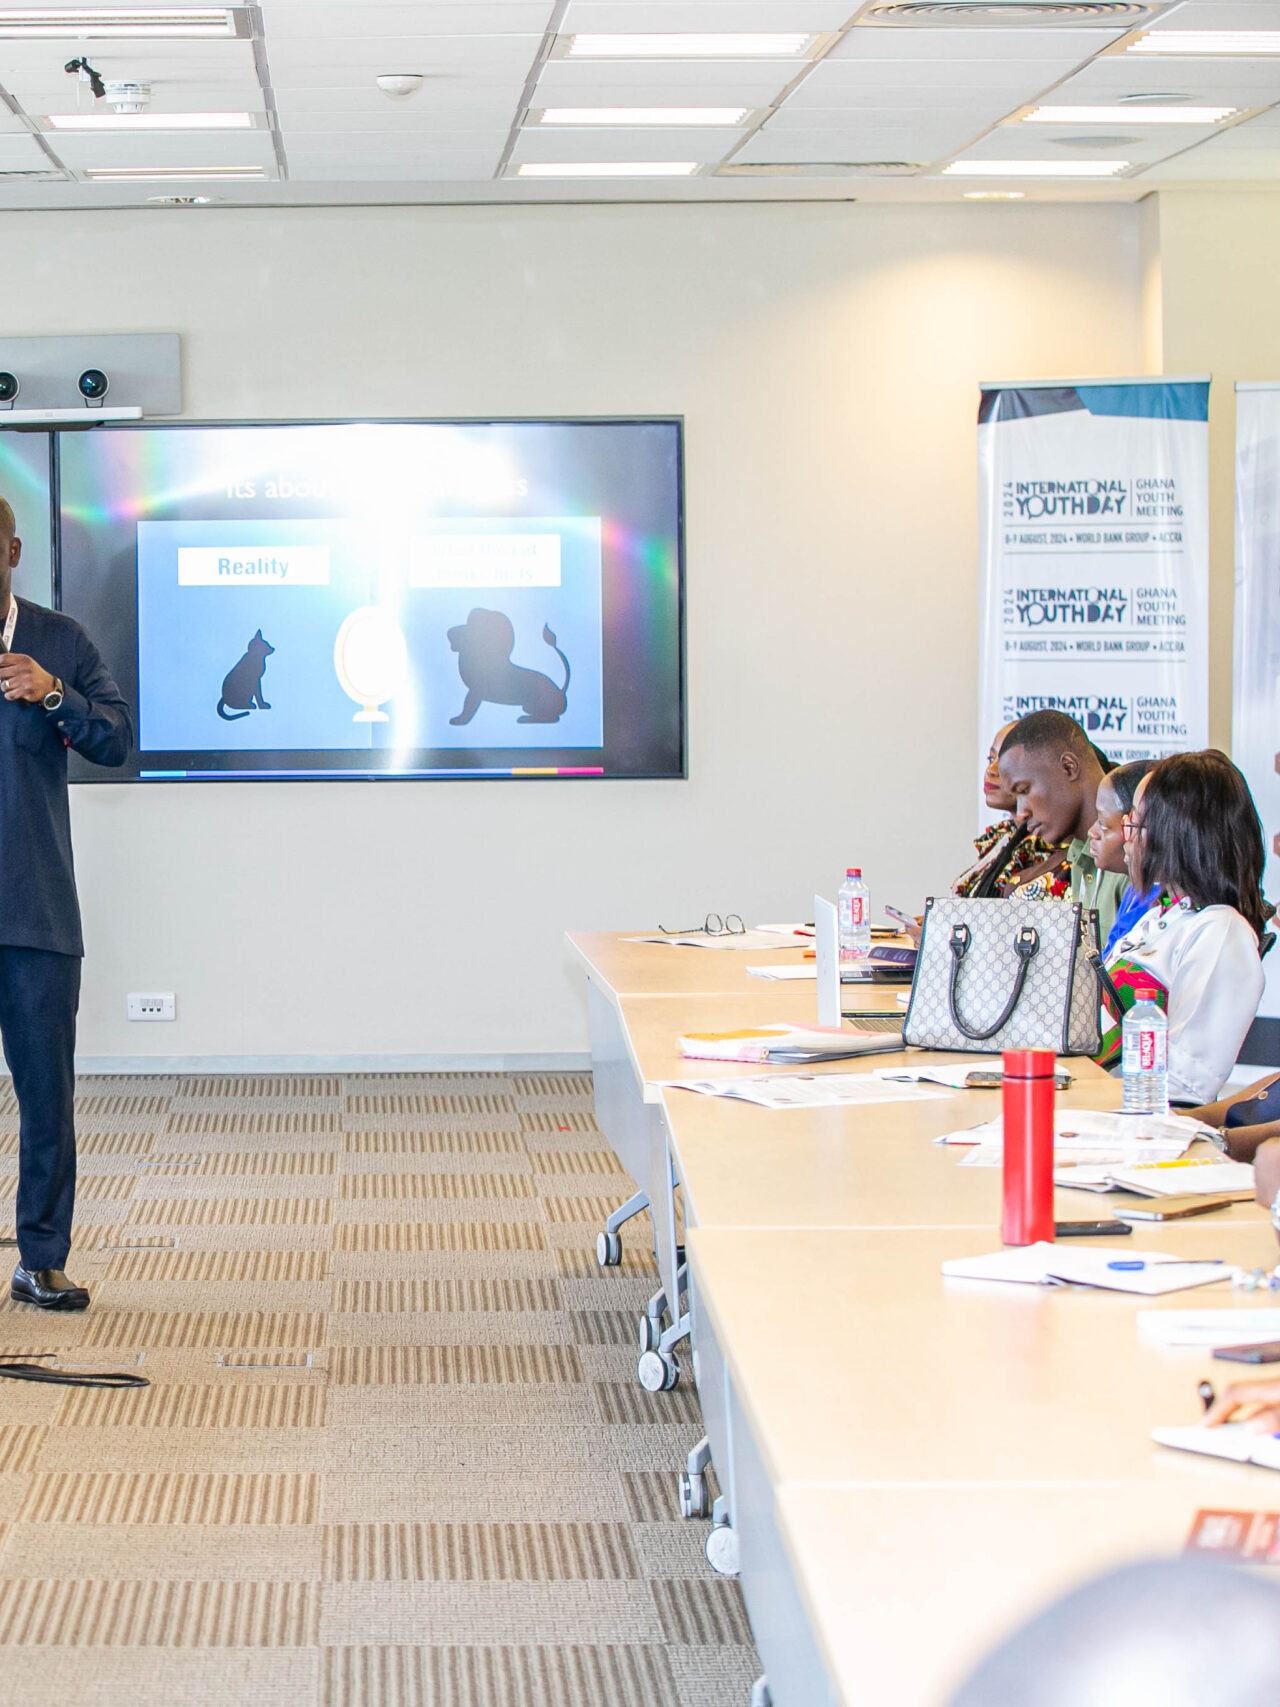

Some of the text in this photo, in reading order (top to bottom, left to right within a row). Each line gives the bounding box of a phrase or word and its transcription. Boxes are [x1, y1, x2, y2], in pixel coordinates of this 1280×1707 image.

[1016, 480, 1127, 494] INTERNATIONAL
[1136, 479, 1175, 489] GHANA
[1136, 492, 1174, 502] YOUTH
[1136, 505, 1183, 517] MEETING
[1076, 533, 1102, 543] WORLD
[1104, 532, 1123, 543] BANK
[1125, 532, 1150, 542] GROUP
[1159, 532, 1182, 542] ACCRA
[218, 557, 289, 578] Reality
[1016, 587, 1127, 602] INTERNATIONAL
[1137, 588, 1177, 598] GHANA
[1137, 602, 1176, 612] YOUTH
[1137, 615, 1186, 626] MEETING
[1076, 641, 1102, 651] WORLD
[1104, 641, 1123, 651] BANK
[1126, 641, 1150, 651] GROUP
[1016, 696, 1127, 711] INTERNATIONAL
[1137, 696, 1176, 707] GHANA
[1004, 696, 1013, 721] 024
[1137, 711, 1176, 721] YOUTH
[1137, 724, 1187, 735] MEETING
